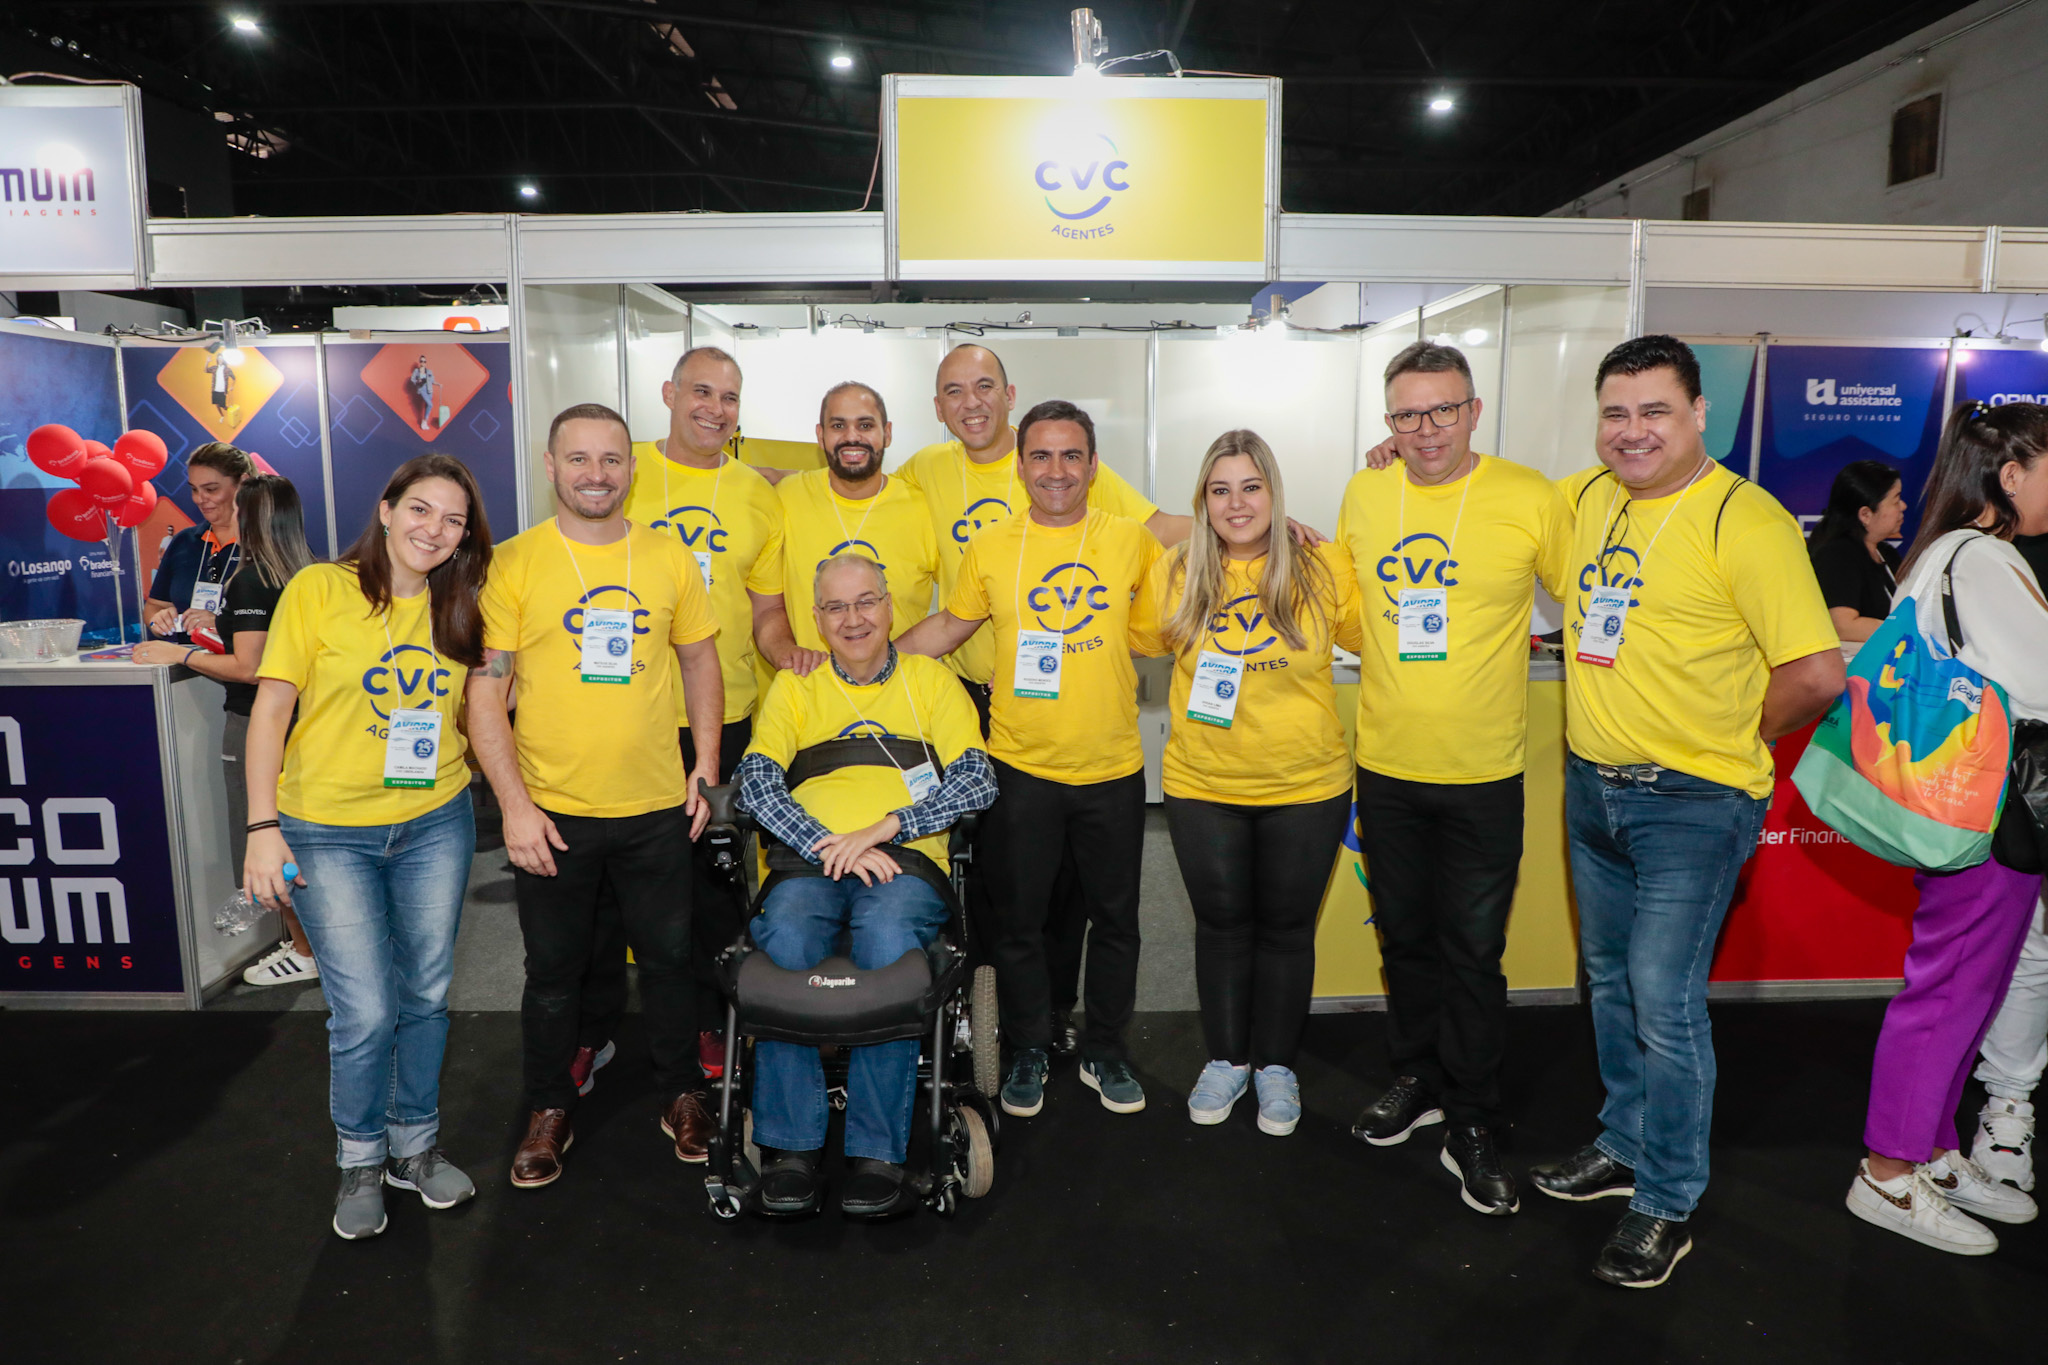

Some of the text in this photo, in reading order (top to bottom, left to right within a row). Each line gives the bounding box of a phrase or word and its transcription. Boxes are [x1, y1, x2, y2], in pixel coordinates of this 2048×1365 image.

[1035, 160, 1130, 191] CVC
[1051, 223, 1115, 240] AGENTES
[1841, 383, 1897, 397] universal
[1840, 395, 1902, 406] assistance
[1804, 413, 1902, 422] SEGURO VIAGEM
[20, 559, 72, 576] Losango
[90, 559, 121, 571] brades
[1376, 555, 1459, 587] CVC
[1028, 585, 1110, 612] CVC
[563, 607, 651, 635] CC
[1207, 613, 1264, 633] CV
[1062, 636, 1104, 654] ENTES
[1246, 657, 1289, 672] NTES
[362, 666, 452, 697] CVC
[822, 976, 856, 988] Jaguaribe
